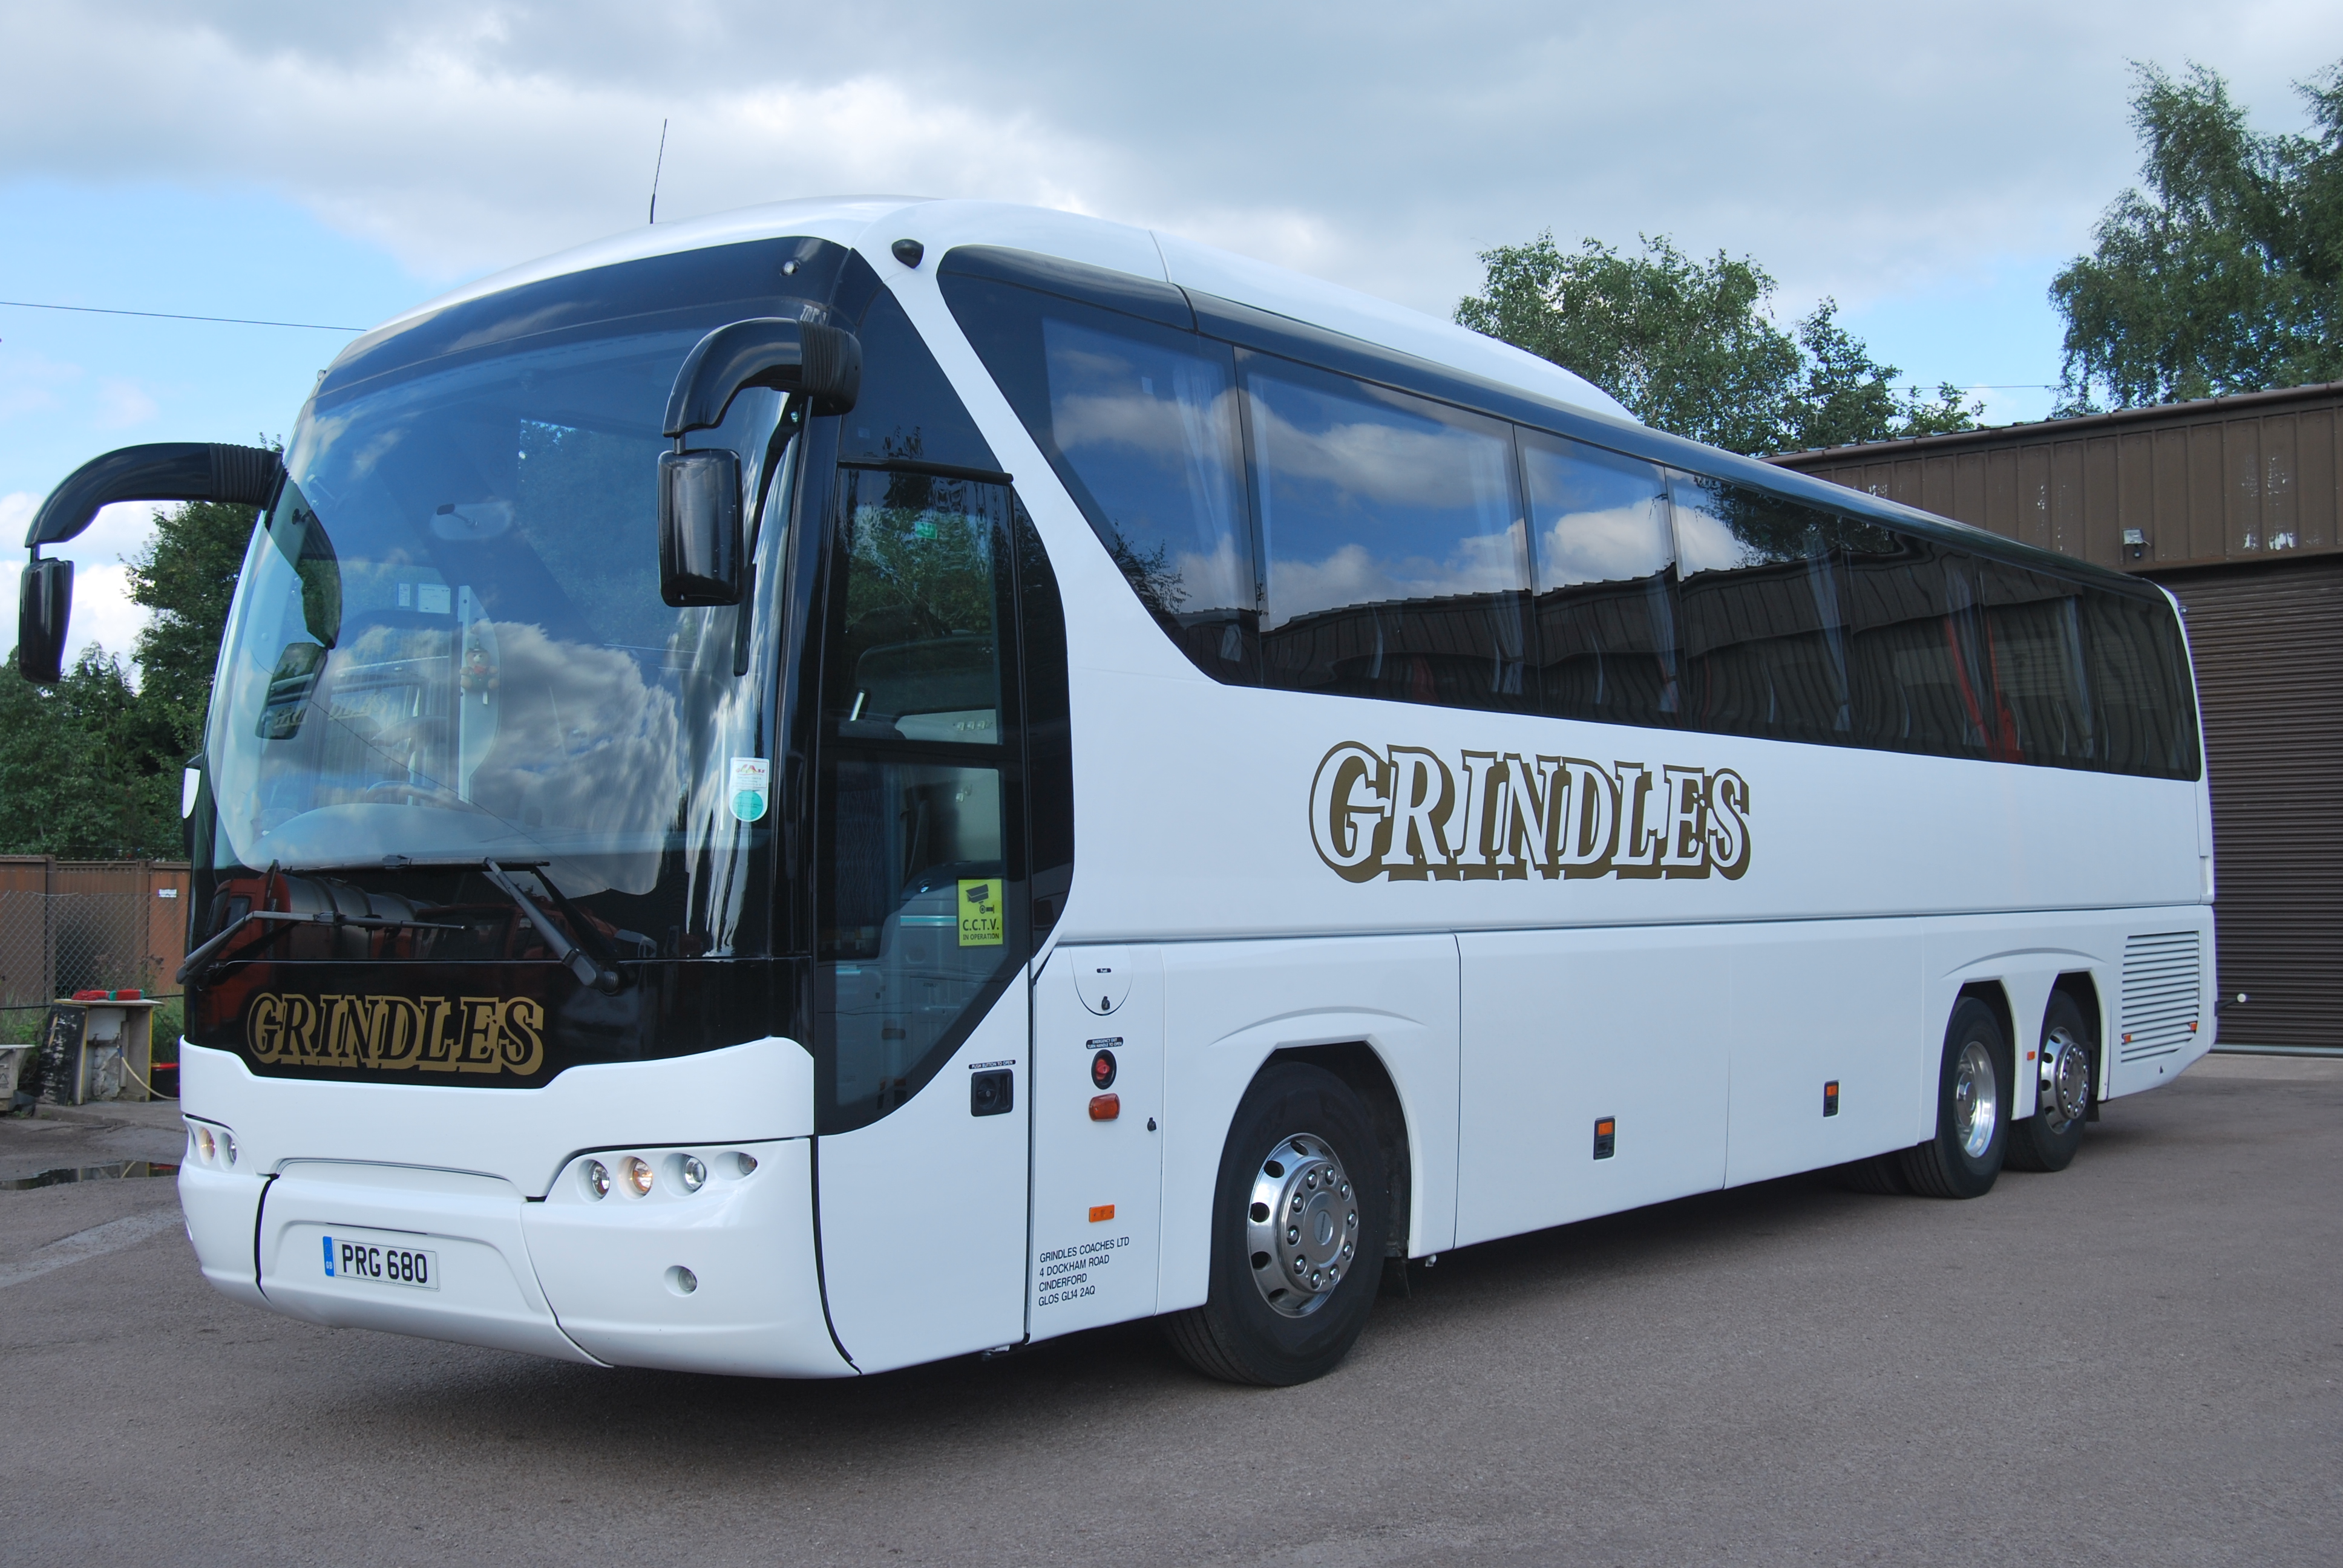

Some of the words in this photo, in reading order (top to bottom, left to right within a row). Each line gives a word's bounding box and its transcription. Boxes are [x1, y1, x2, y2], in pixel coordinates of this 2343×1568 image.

[1309, 741, 1751, 883] GRINDLES
[963, 918, 999, 931] C.C.T.V.
[247, 992, 544, 1076] GRINDLES
[1040, 1247, 1077, 1263] GRINDLES
[1080, 1239, 1114, 1255] COACHES
[1116, 1236, 1130, 1247] LTD
[326, 1261, 333, 1270] GB
[342, 1244, 381, 1277] PRG
[387, 1250, 427, 1284] 680
[1040, 1268, 1044, 1277] 4
[1047, 1259, 1086, 1276] DOCKHAM
[1089, 1255, 1110, 1267] ROAD
[1039, 1273, 1087, 1292] CINDERFORD
[1038, 1293, 1059, 1307] GLOS
[1061, 1289, 1078, 1301] GL14
[1080, 1285, 1096, 1298] 2AQ
